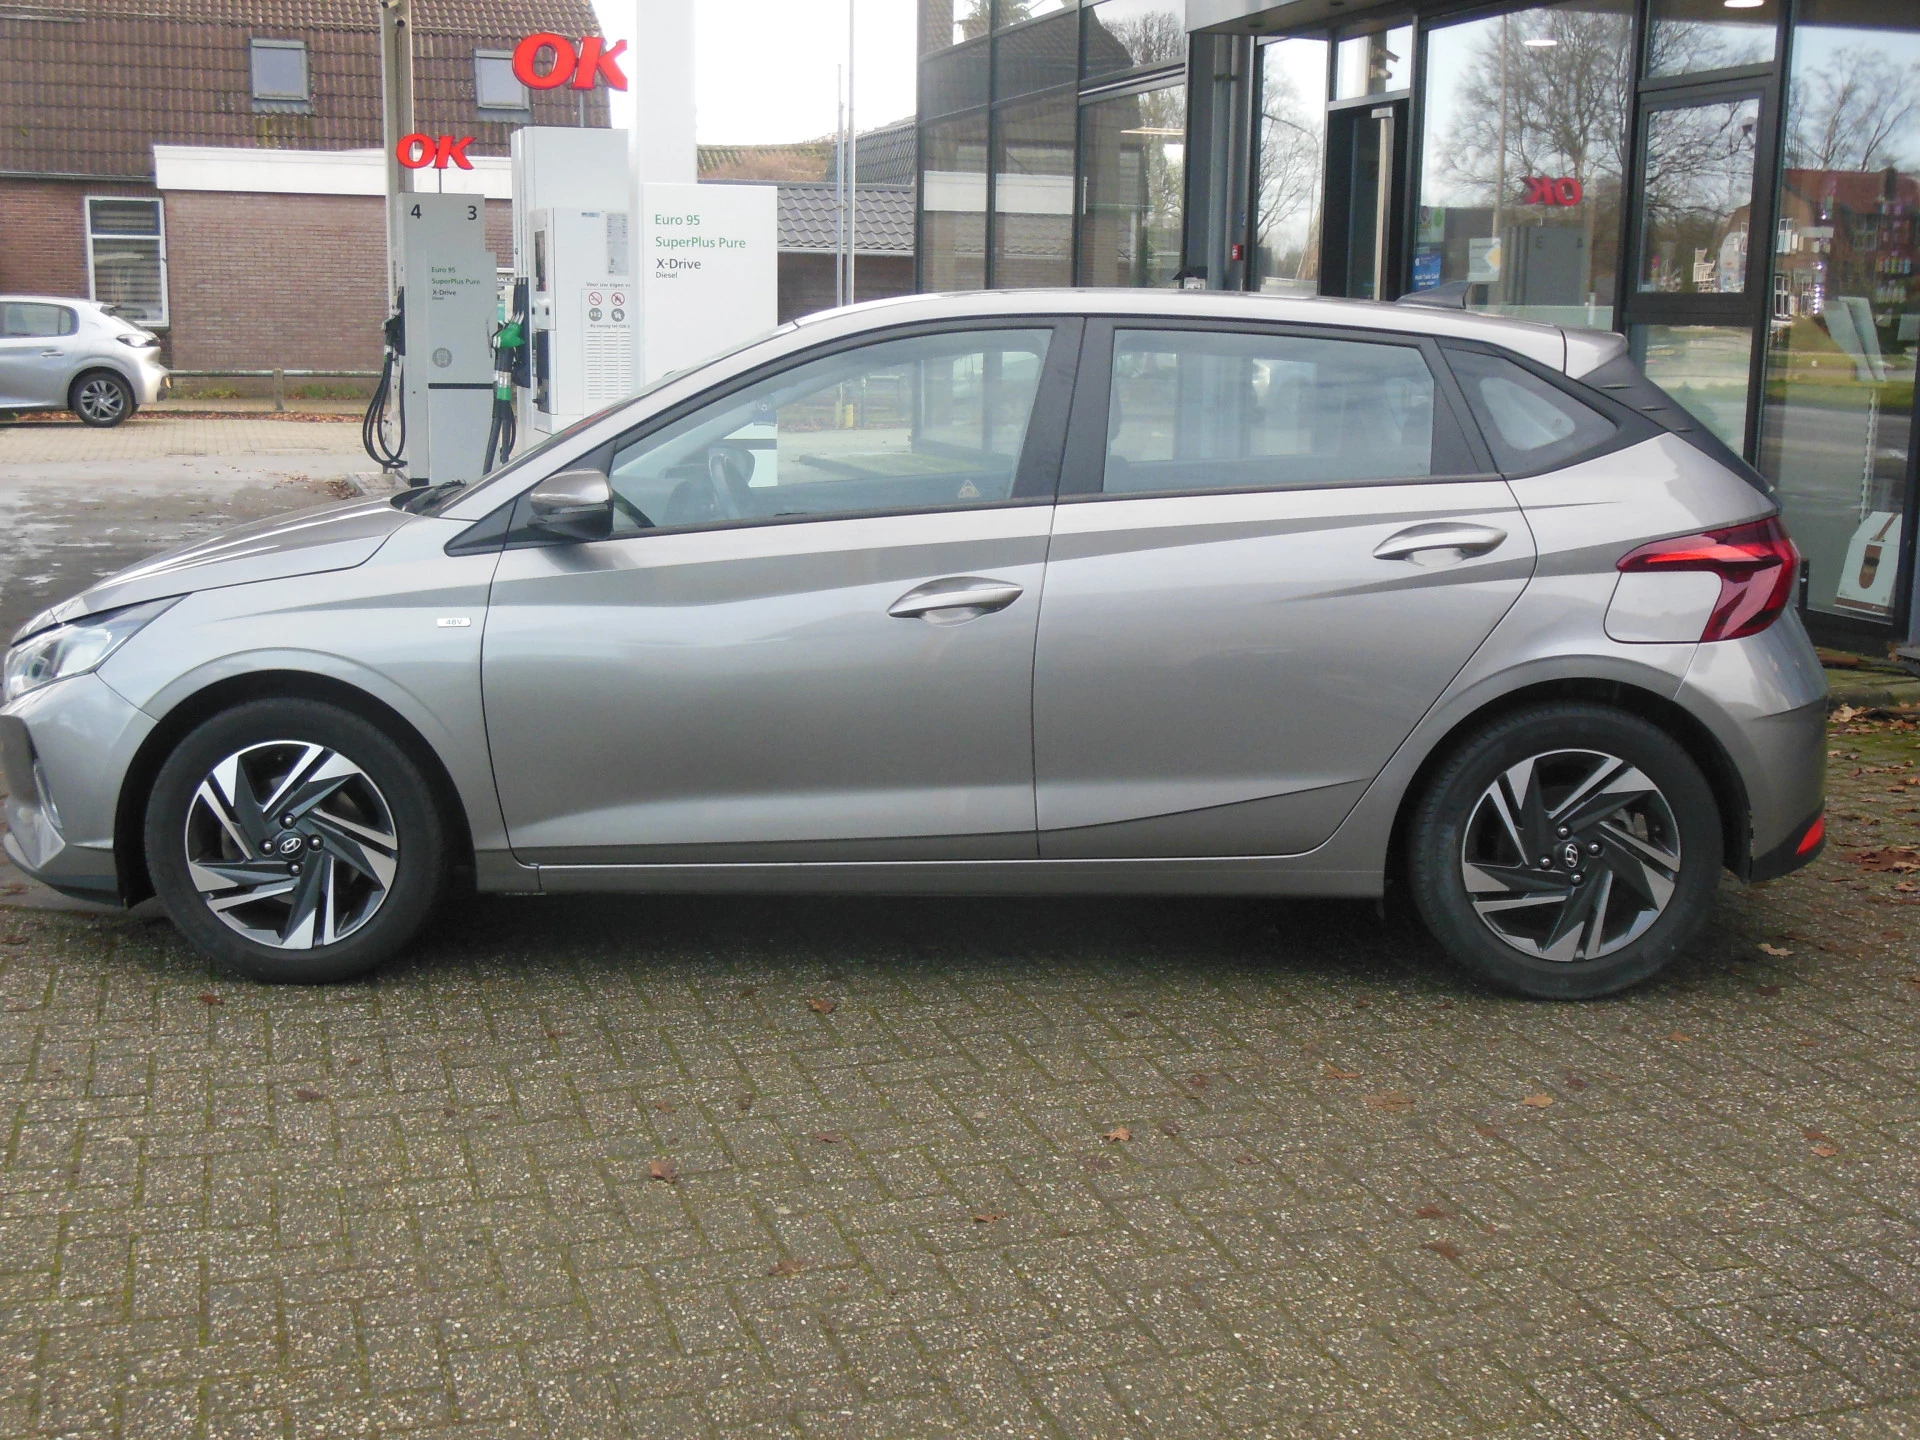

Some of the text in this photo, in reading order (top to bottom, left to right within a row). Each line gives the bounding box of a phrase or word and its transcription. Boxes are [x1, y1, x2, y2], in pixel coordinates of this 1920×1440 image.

[512, 32, 628, 91] OK
[396, 132, 476, 170] OK
[410, 204, 422, 219] 4
[467, 205, 478, 220] 3
[655, 214, 701, 225] Euro 95
[655, 236, 746, 250] SuperPlus Pure
[656, 258, 701, 269] X-Drive
[655, 271, 678, 279] Diesel
